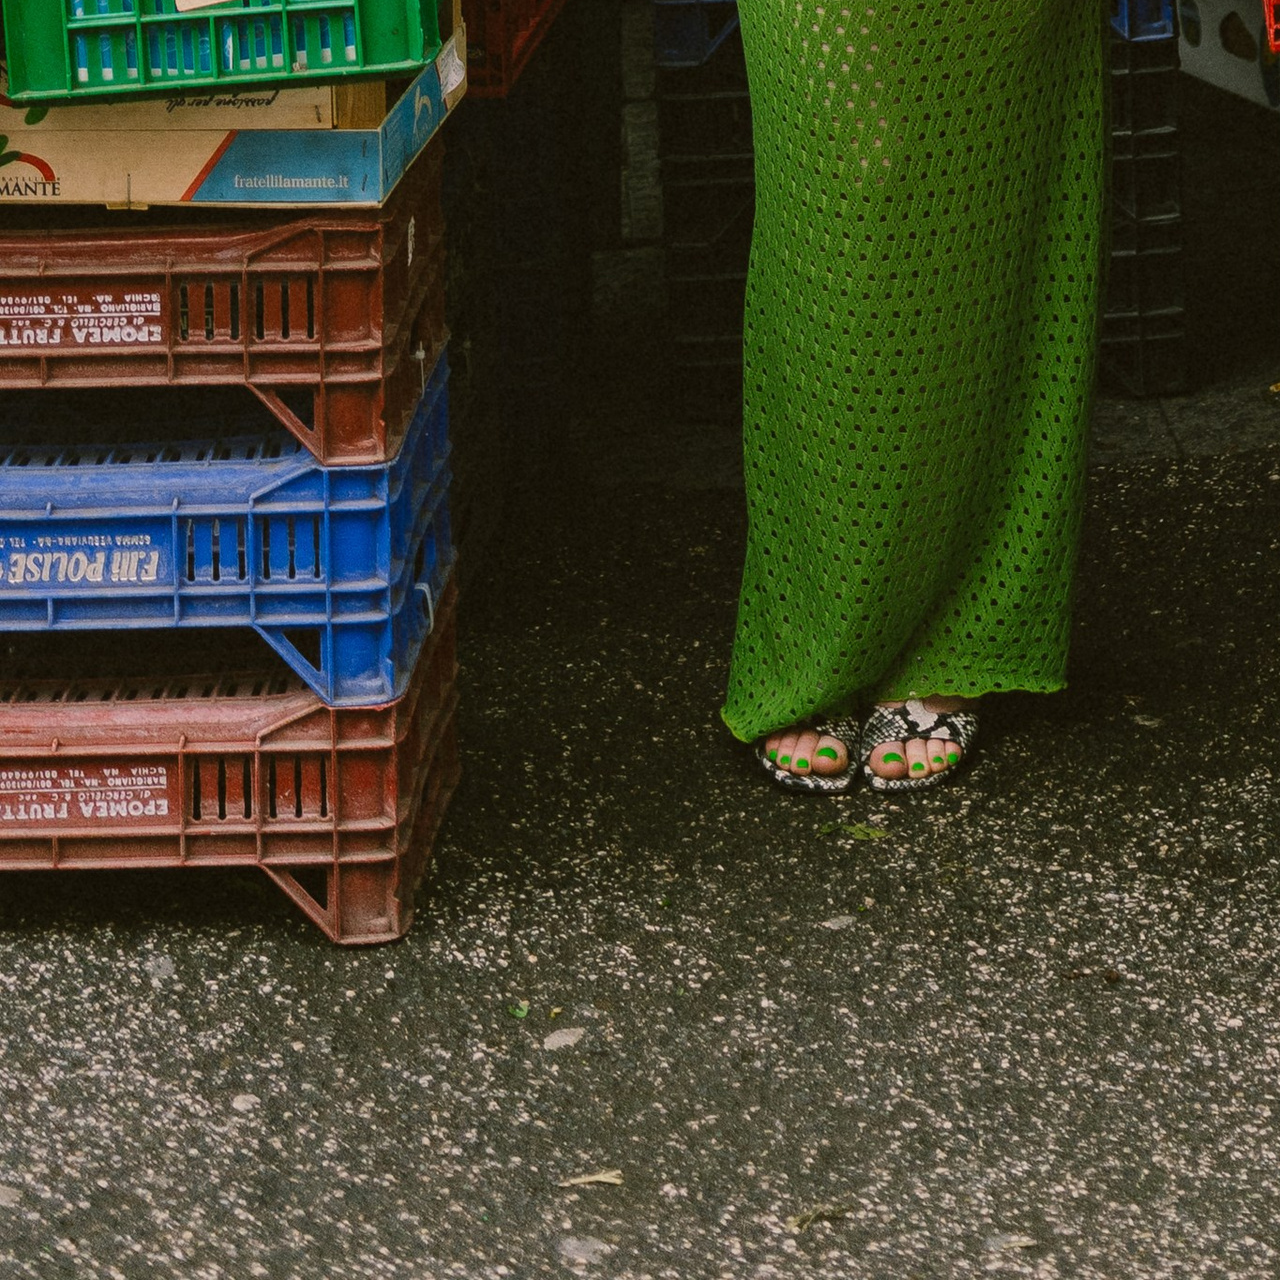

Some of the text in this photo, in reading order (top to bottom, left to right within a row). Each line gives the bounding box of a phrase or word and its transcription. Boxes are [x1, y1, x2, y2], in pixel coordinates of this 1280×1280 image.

[234, 174, 349, 190] fratellilamante.it
[72, 325, 162, 343] EPOMEA
[114, 535, 151, 546] SOMMA
[7, 552, 106, 585] POLISE
[0, 799, 169, 821] EPOMEA FRUTT
